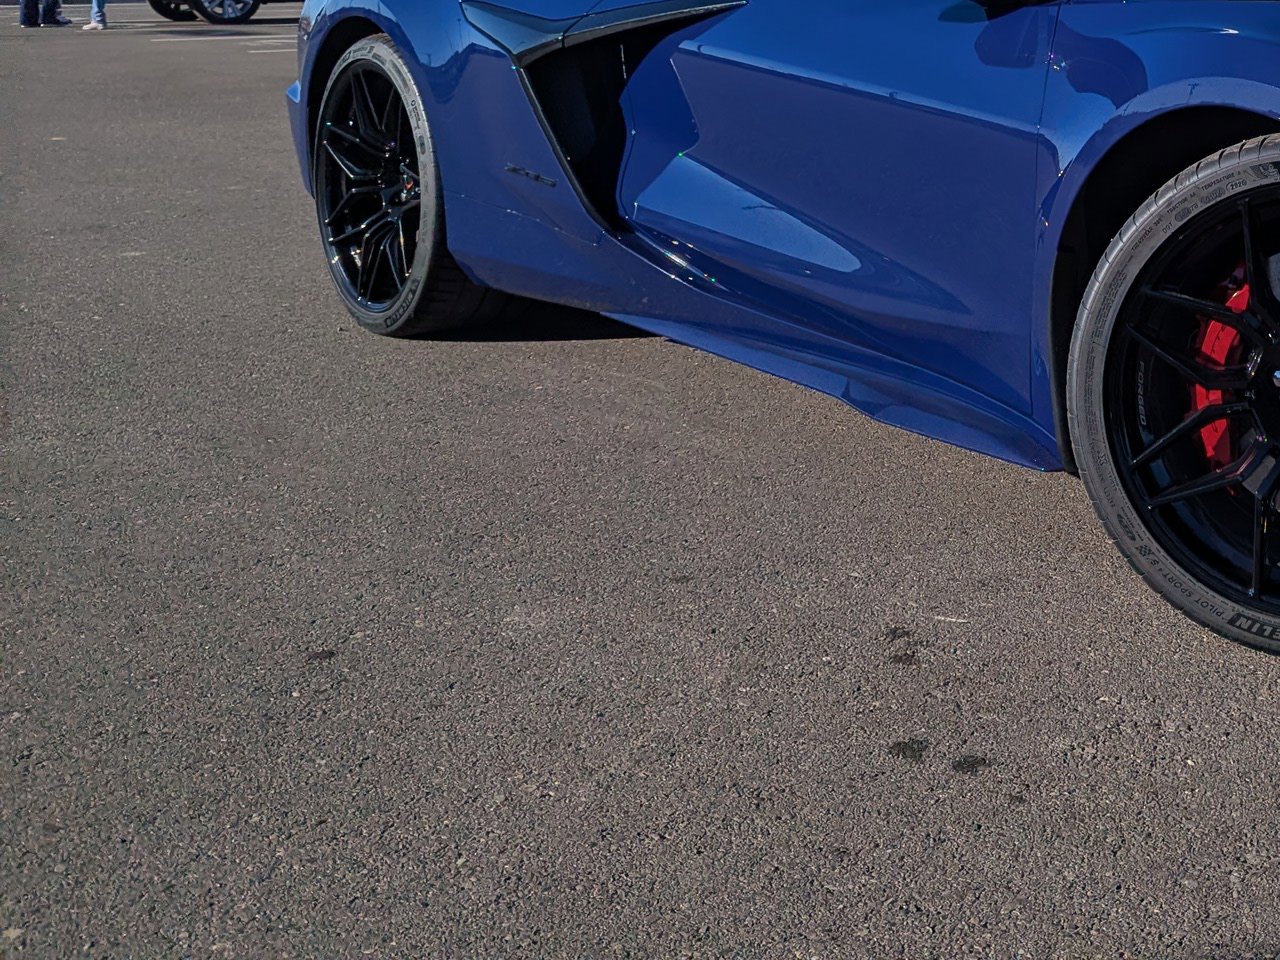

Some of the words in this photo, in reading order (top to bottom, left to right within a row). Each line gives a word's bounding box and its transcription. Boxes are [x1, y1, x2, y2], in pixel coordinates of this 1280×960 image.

[1137, 361, 1147, 425] FORGED
[1164, 572, 1192, 597] SPORT
[1193, 597, 1225, 617] PILOT
